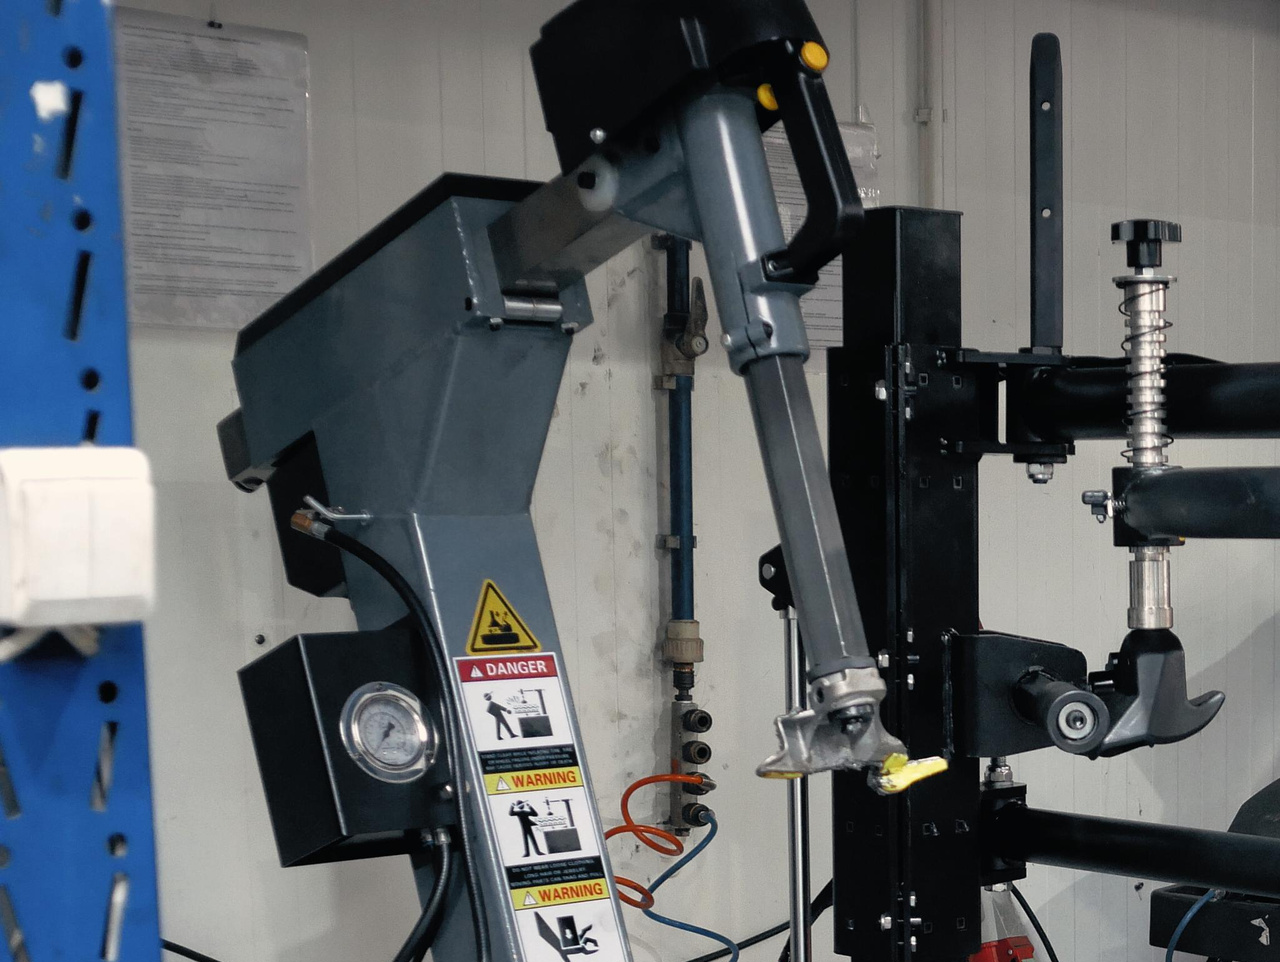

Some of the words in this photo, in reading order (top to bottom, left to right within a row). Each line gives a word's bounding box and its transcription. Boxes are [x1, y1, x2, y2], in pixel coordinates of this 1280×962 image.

[486, 660, 547, 676] DANGER
[511, 771, 576, 787] WARNING
[538, 883, 603, 902] WARNING
